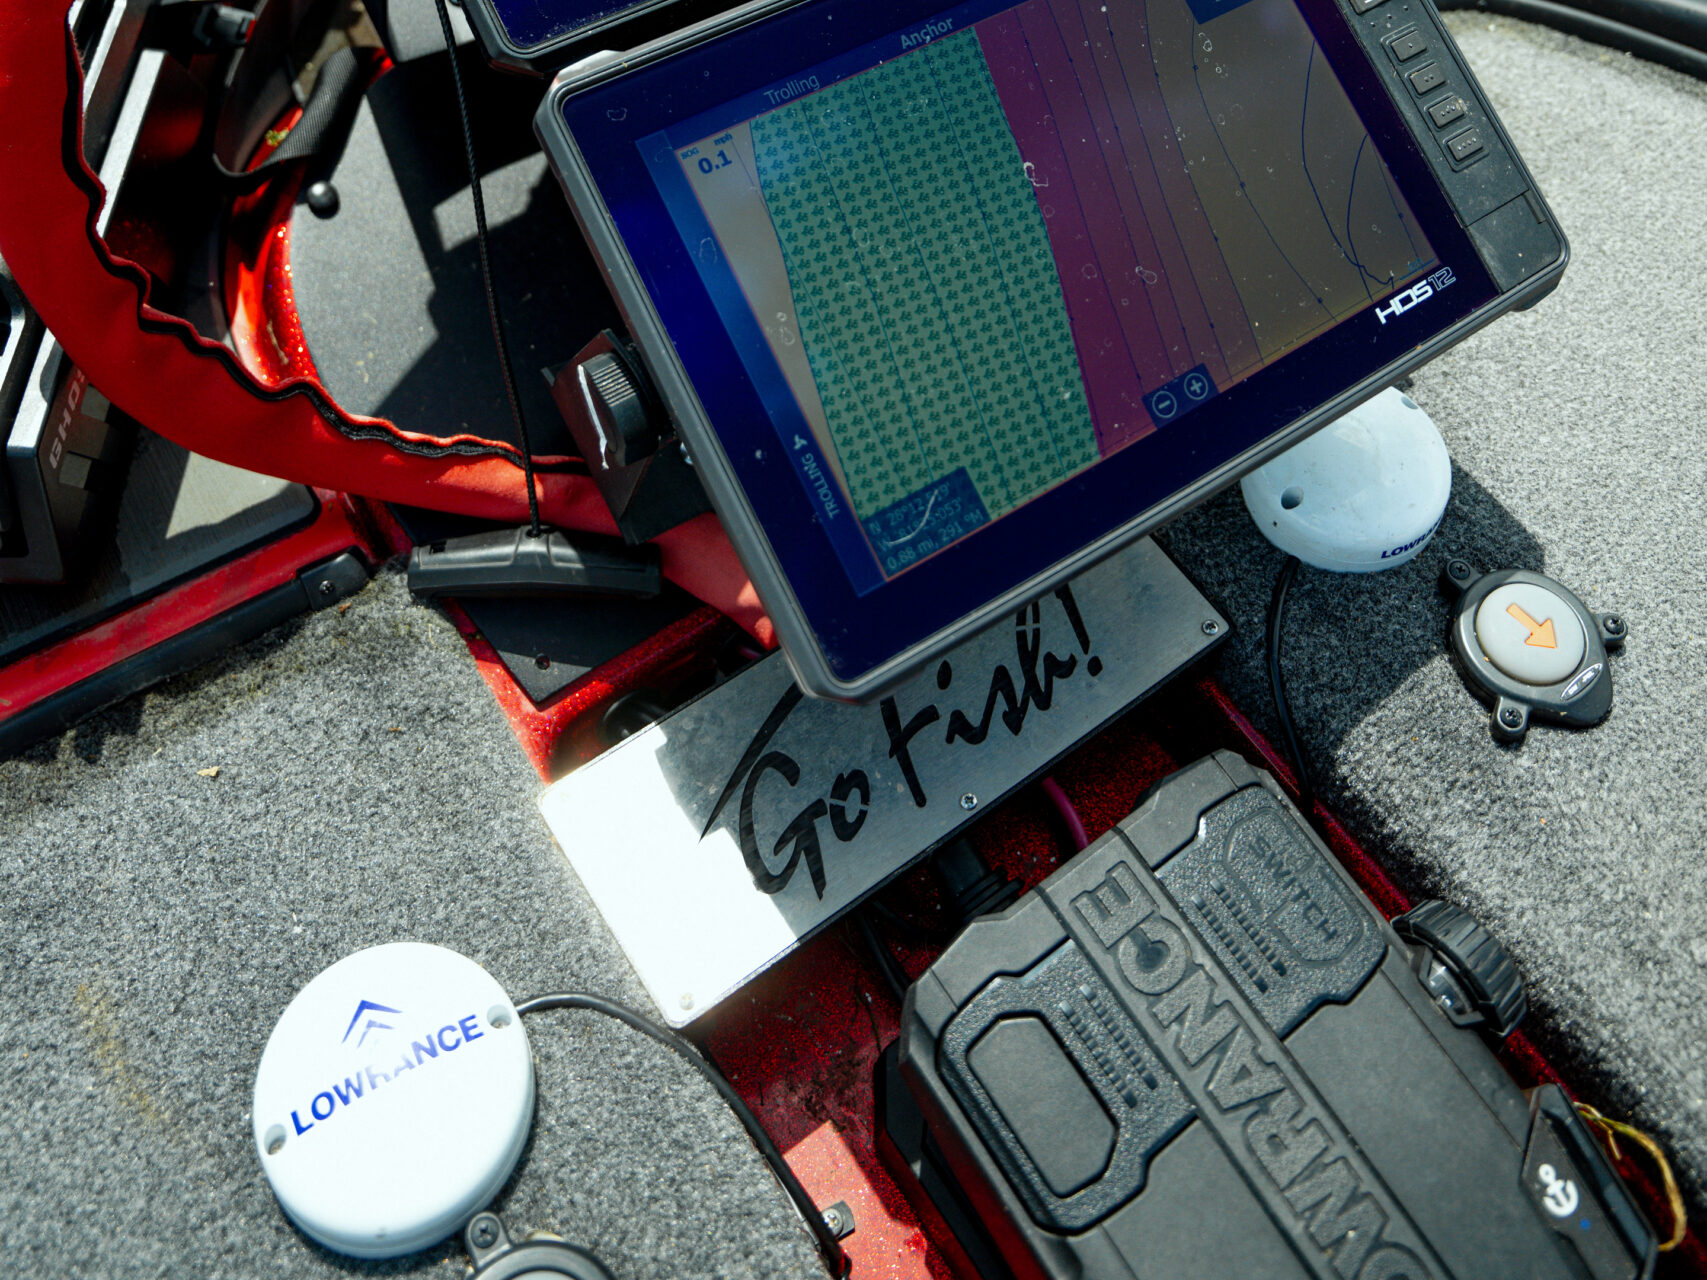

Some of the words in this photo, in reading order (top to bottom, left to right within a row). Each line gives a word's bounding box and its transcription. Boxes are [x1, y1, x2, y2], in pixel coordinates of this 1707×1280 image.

[900, 17, 953, 50] Anchor
[763, 74, 821, 105] Trolling
[697, 149, 733, 174] 0.1
[801, 452, 841, 520] TROLLING
[738, 750, 870, 901] Go
[1250, 833, 1339, 943] SWITCH
